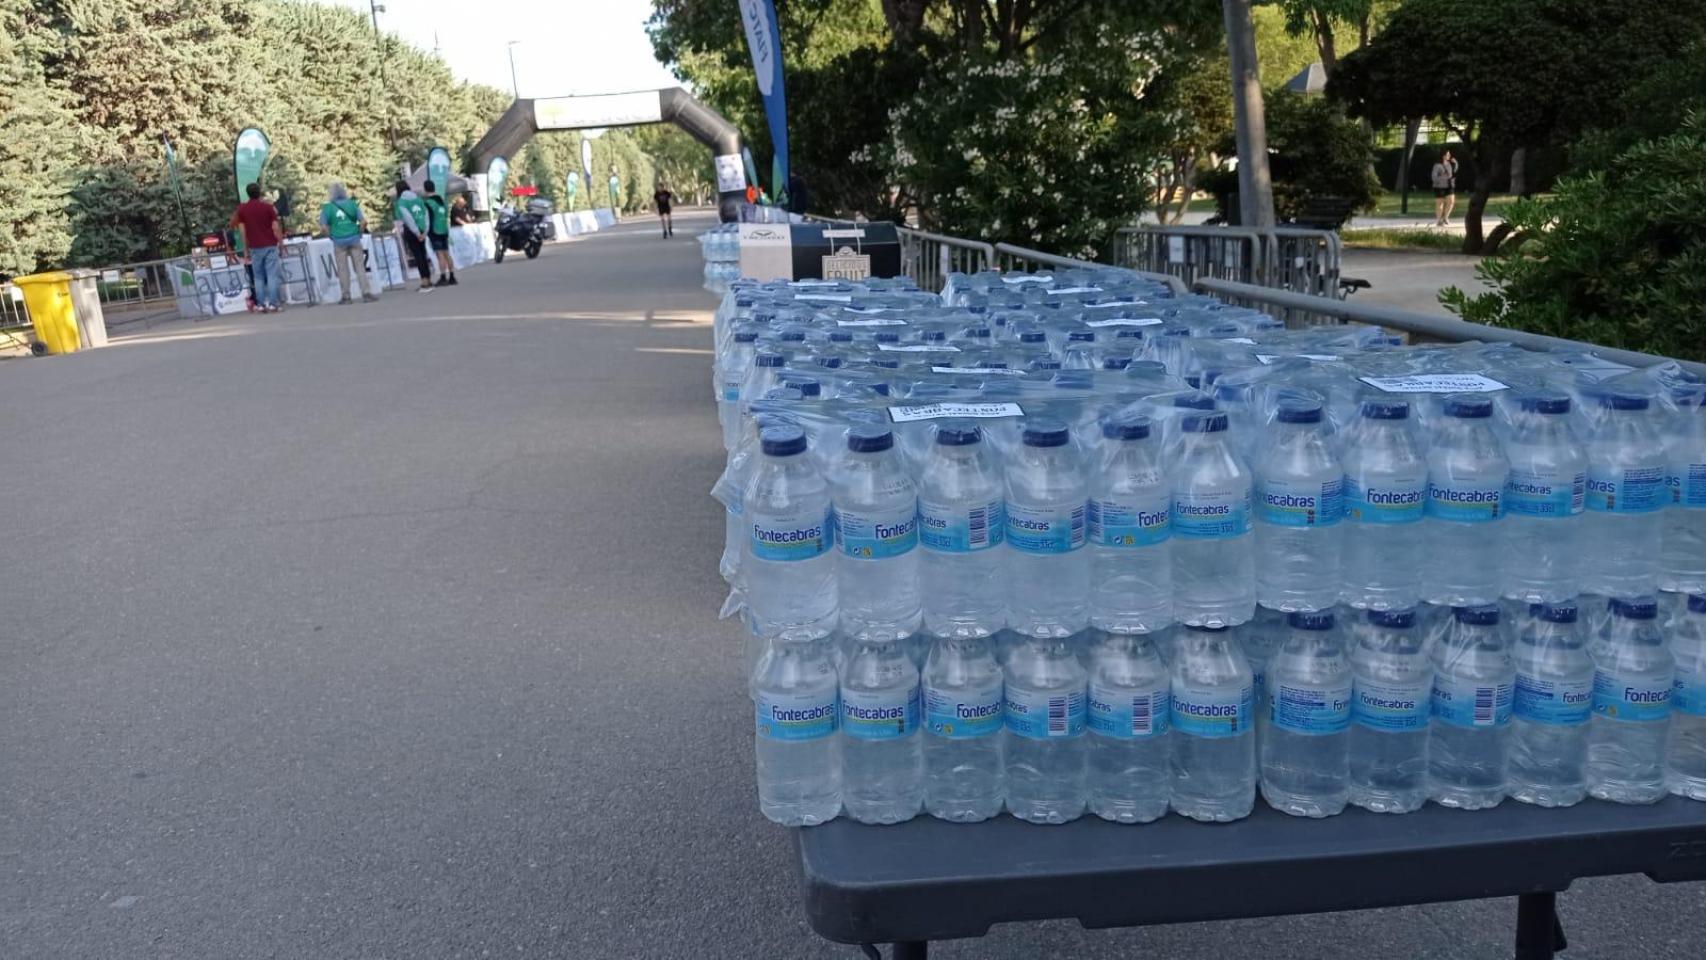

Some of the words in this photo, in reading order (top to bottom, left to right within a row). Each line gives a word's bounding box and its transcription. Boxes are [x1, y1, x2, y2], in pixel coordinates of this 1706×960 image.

[1264, 494, 1315, 508] ecabras
[1429, 482, 1499, 502] Fontecabras
[1176, 502, 1229, 515] Fontecabras
[754, 524, 821, 543] Fontecabras
[843, 700, 904, 719] Fontecabras
[1173, 696, 1237, 716] Fontecabras
[1361, 692, 1415, 709] Fontecabras
[772, 703, 835, 721] Fontecabras
